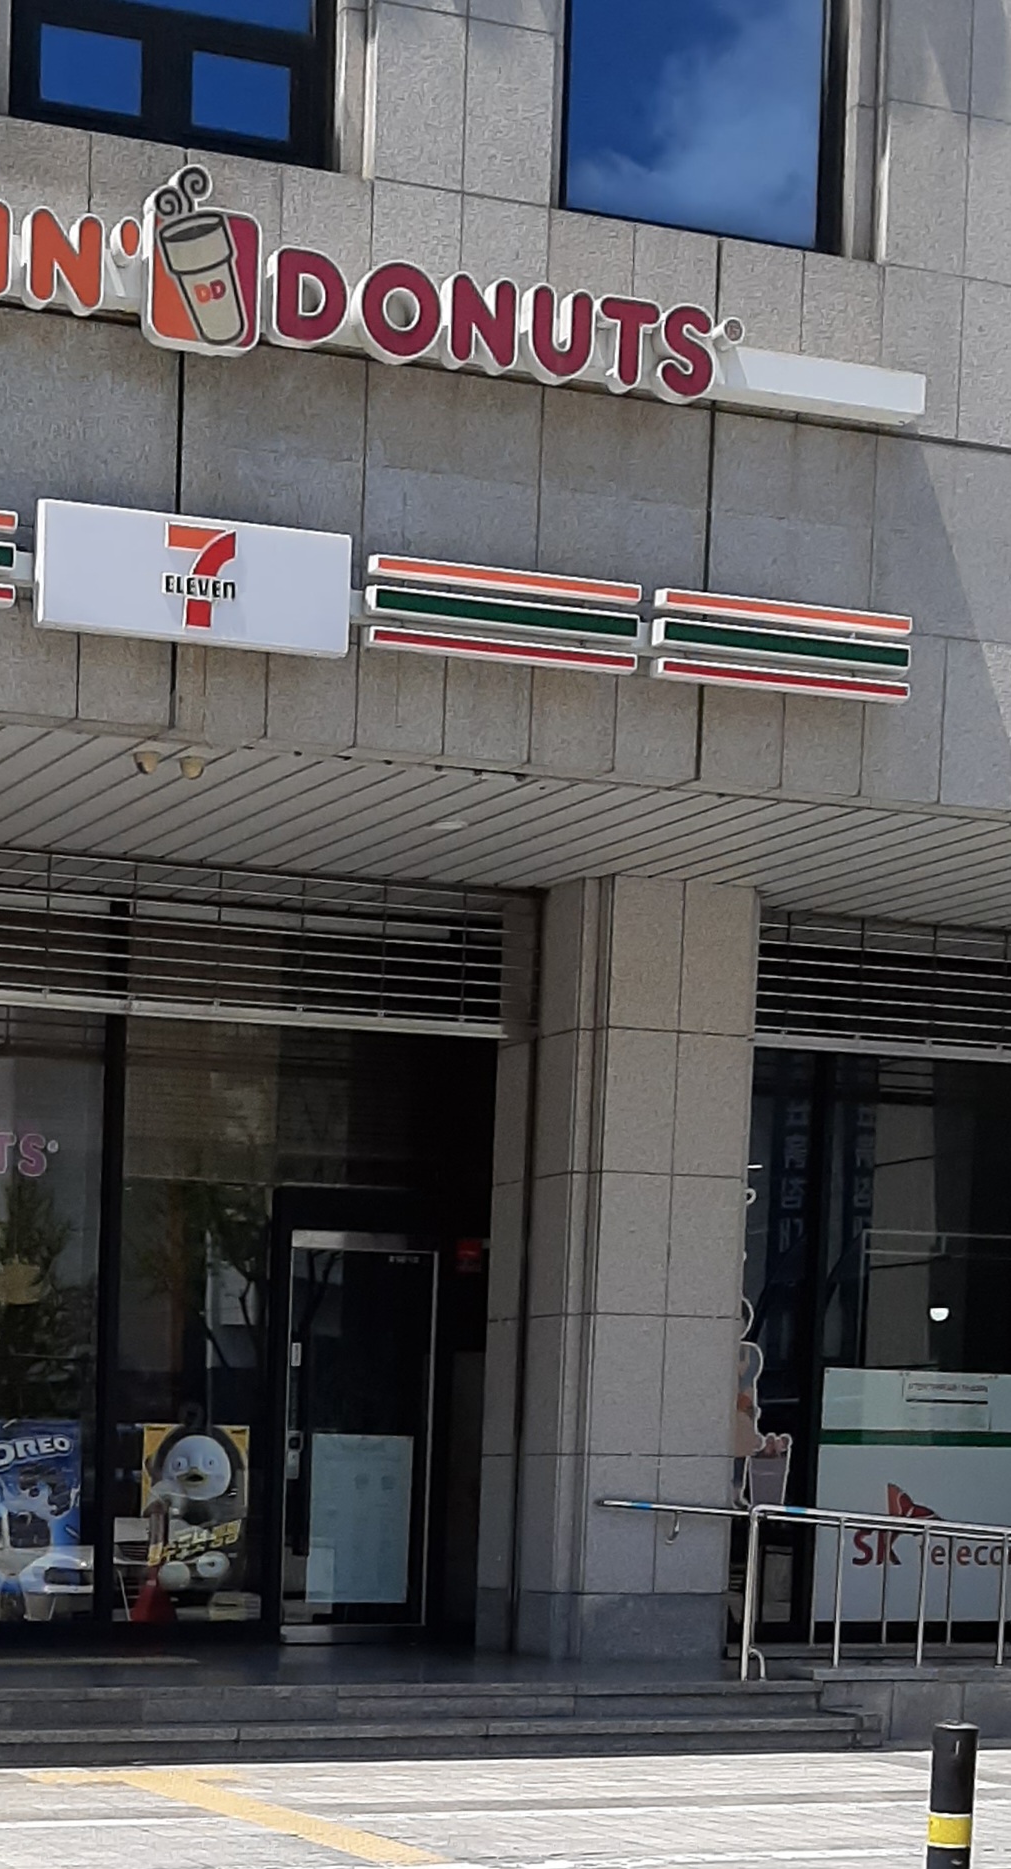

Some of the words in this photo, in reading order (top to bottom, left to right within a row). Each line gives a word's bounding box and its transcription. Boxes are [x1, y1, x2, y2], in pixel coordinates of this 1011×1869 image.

[194, 279, 227, 303] DD
[269, 245, 715, 402] DONUTS
[165, 521, 237, 629] 7
[852, 1529, 901, 1566] SK
